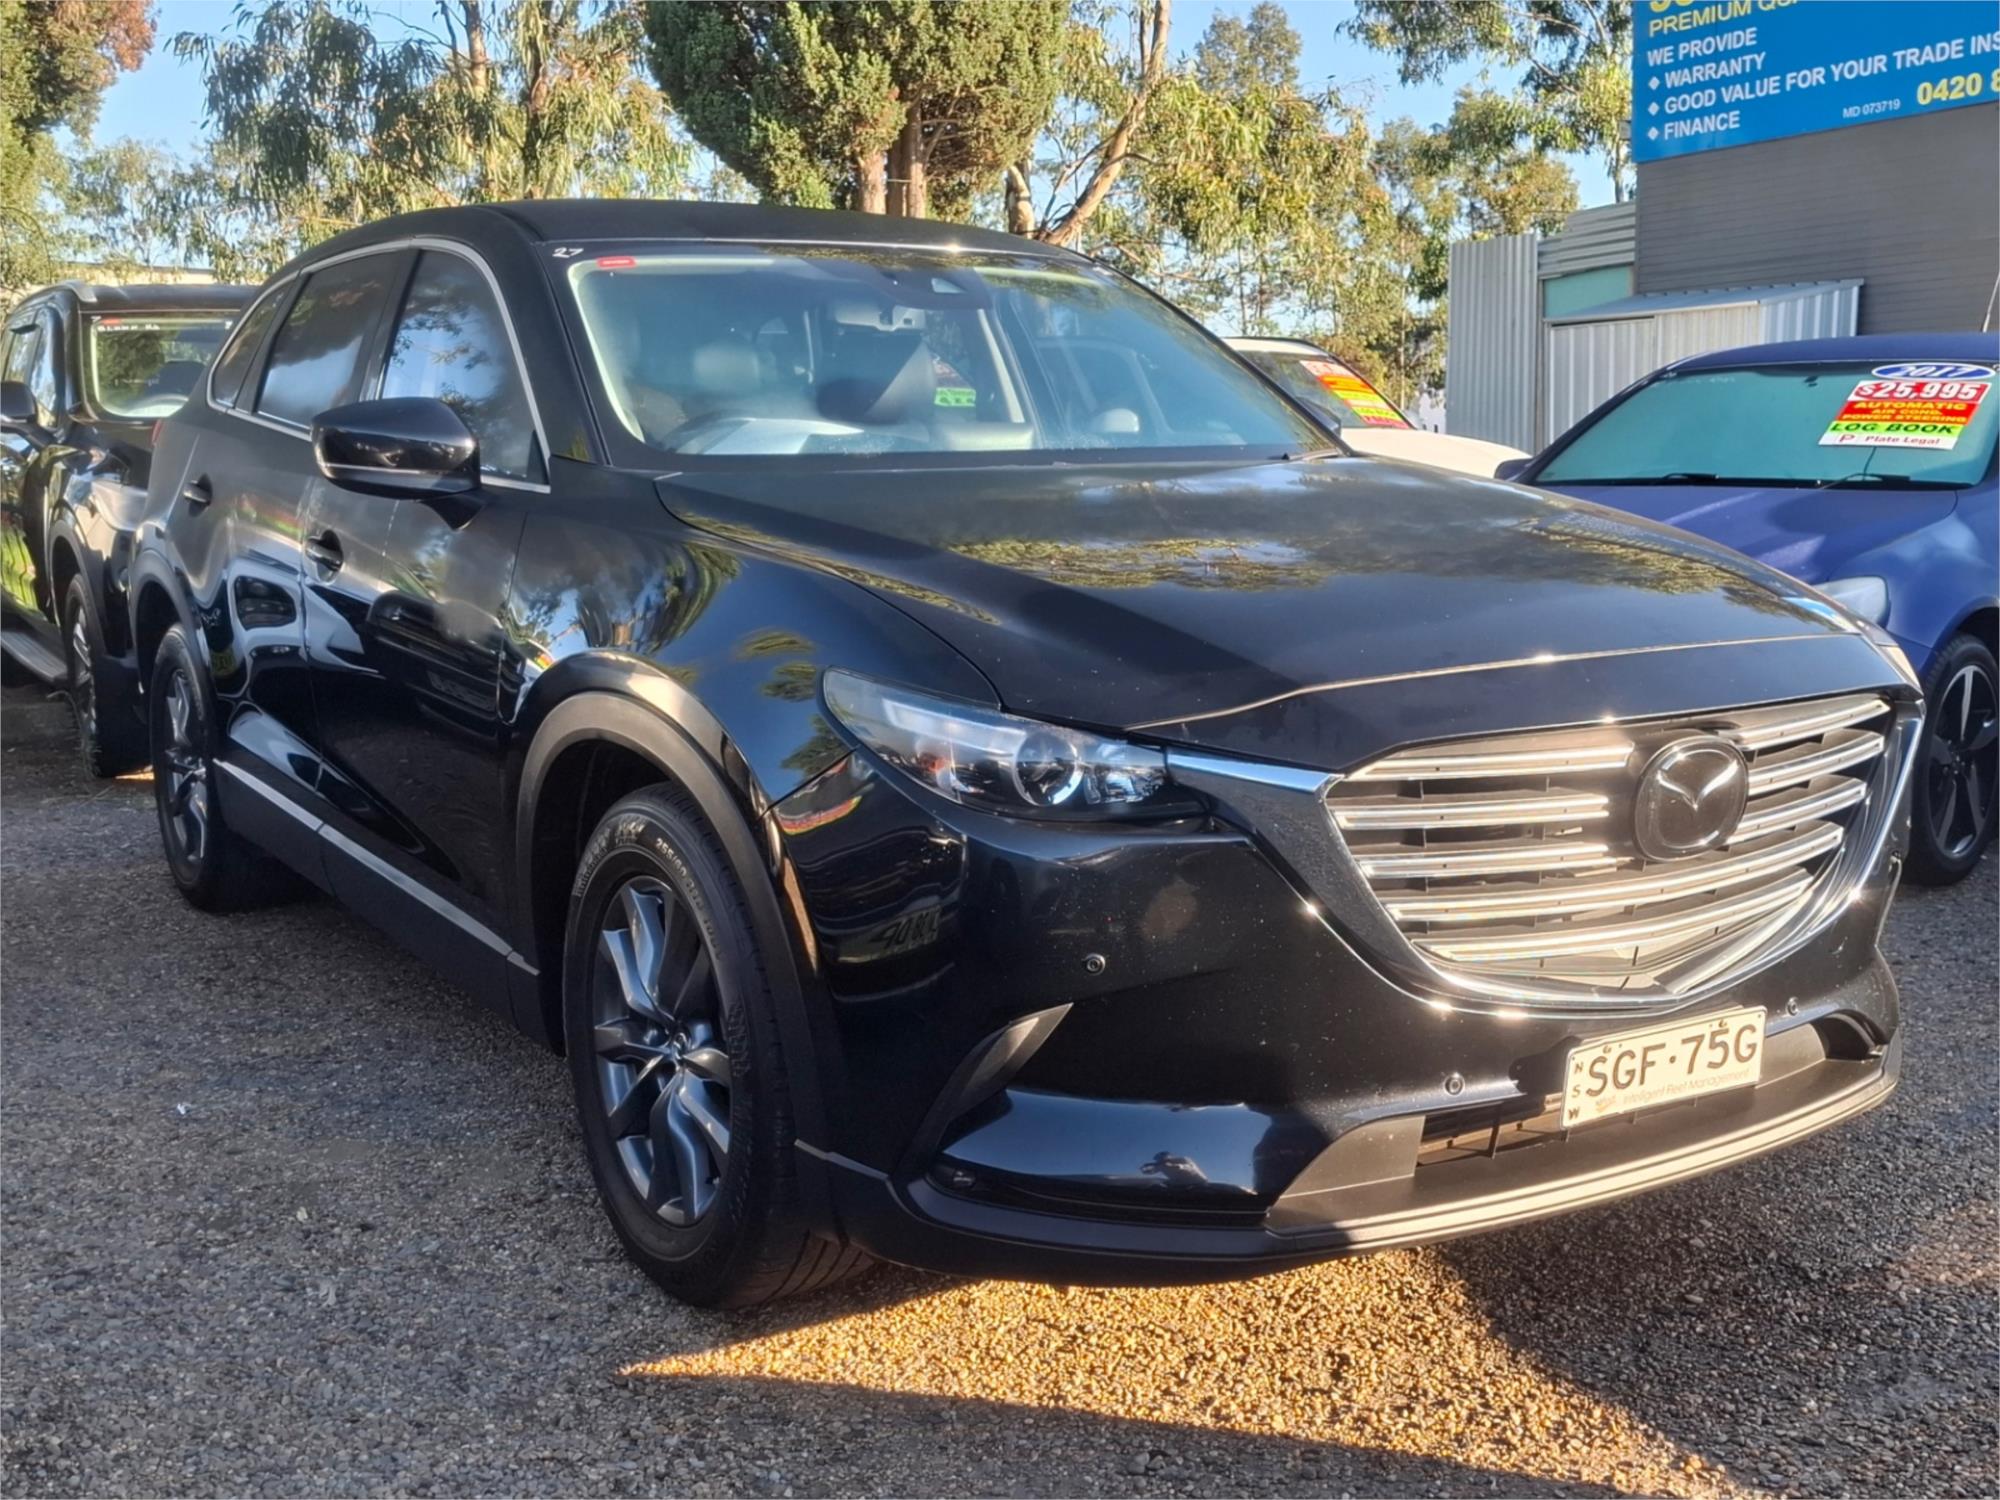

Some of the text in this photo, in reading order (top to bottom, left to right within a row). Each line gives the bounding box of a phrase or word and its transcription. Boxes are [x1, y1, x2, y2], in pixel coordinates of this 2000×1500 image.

[1649, 0, 1752, 37] PREMIUM
[1647, 27, 1757, 66] WE PROVIDE
[1664, 51, 1766, 88] WARRANTY
[1664, 30, 2000, 114] GOOD VALUE FOR YOUR TRADE INS
[1916, 72, 1983, 106] 0420
[1842, 98, 1900, 119] MD 073719
[1664, 110, 1741, 140] FINANCE
[1890, 365, 1980, 378] 2017
[1856, 381, 1980, 400] $25,995
[1853, 401, 1967, 410] AUTOMATIC
[1829, 423, 1955, 434] LOG BOOK
[1864, 435, 1901, 443] Plate
[1903, 437, 1941, 446] Legal
